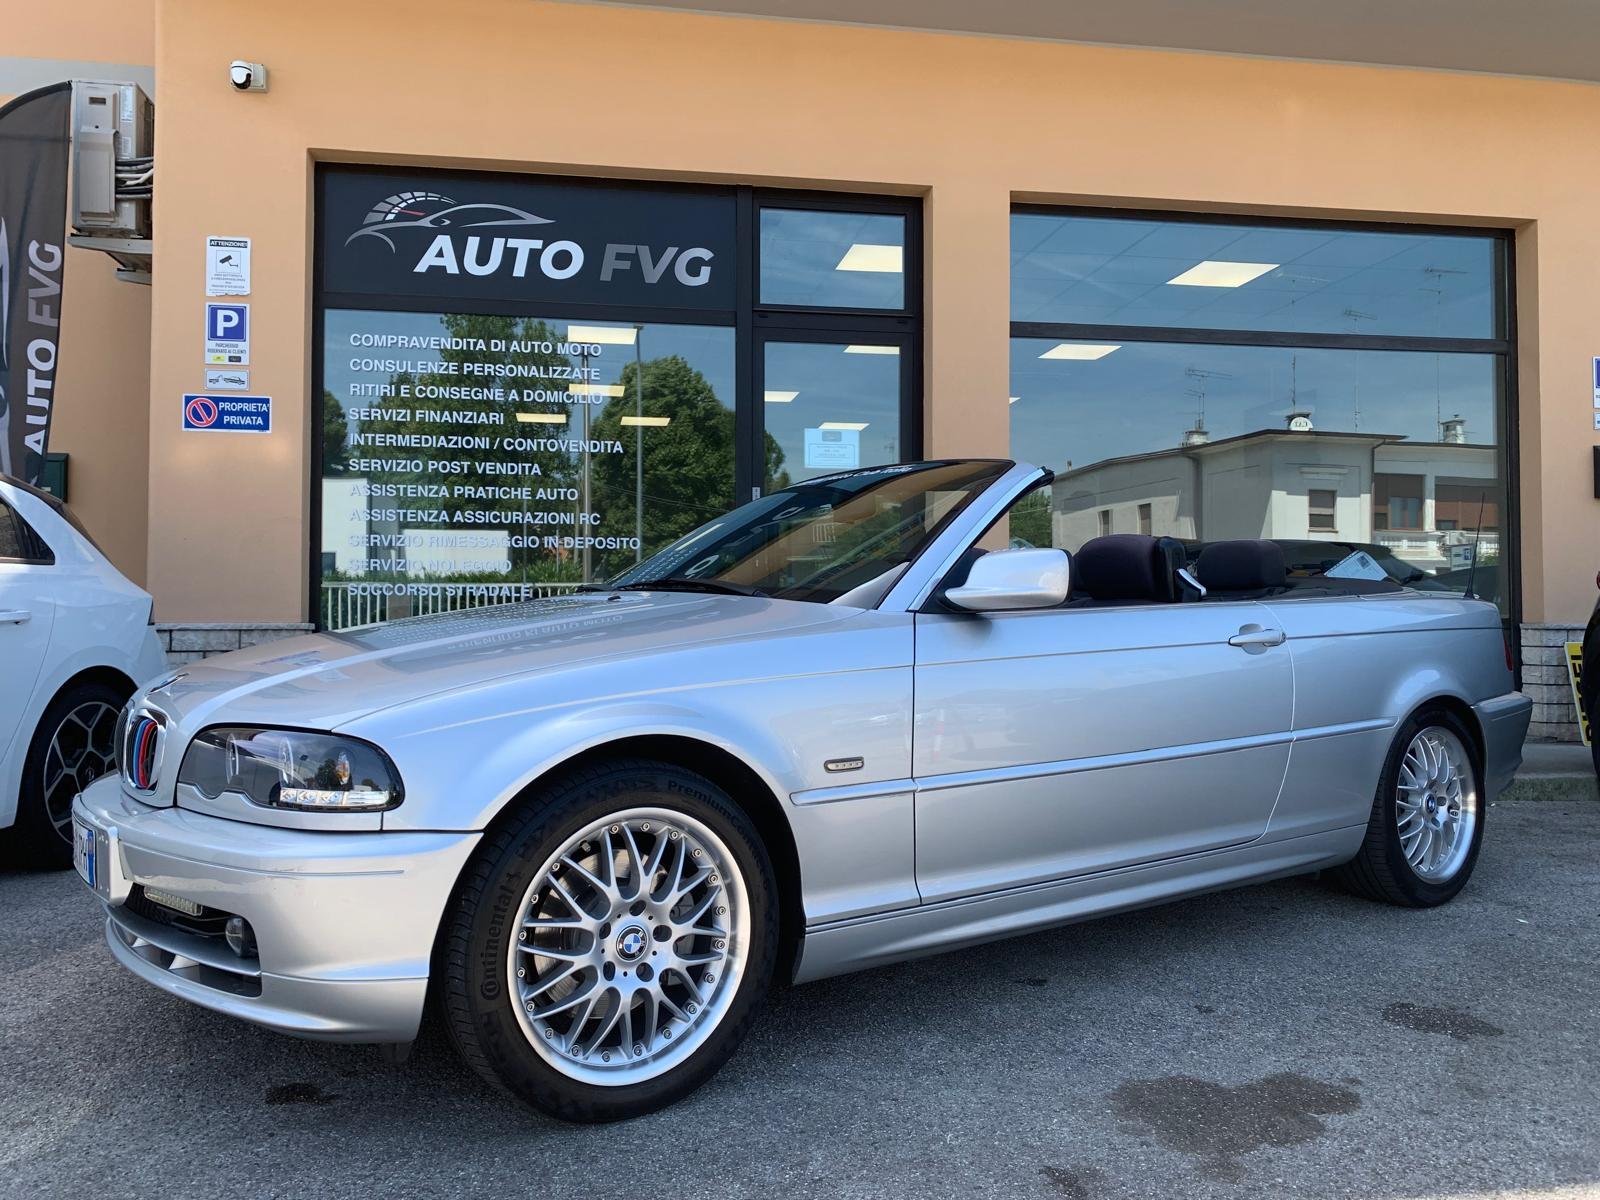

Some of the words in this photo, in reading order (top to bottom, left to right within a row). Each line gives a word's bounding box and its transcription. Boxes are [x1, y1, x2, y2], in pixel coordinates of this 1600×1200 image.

[413, 234, 584, 280] AUTO
[600, 243, 714, 287] FVG
[28, 240, 62, 328] FVG
[217, 310, 239, 337] P
[350, 333, 486, 351] COMPRAVENDITA
[490, 339, 506, 352] DI
[510, 340, 553, 354] AUTO
[557, 342, 602, 357] MOTO
[349, 358, 459, 375] CONSULENZE
[463, 362, 601, 380] PERSONALIZZATE
[24, 338, 57, 456] AUTO
[350, 383, 395, 397] RITIRI
[400, 385, 410, 398] E
[415, 386, 505, 401] CONSEGNE
[508, 389, 519, 402] A
[523, 389, 603, 405] DOMICILIO
[223, 415, 263, 425] PRIVATA
[348, 408, 411, 421] SERVIZI
[415, 410, 504, 424] FINANZIARI
[349, 432, 490, 449] INTERMEDIAZIONI
[503, 438, 624, 453] CONTOVENDITA
[348, 459, 423, 472] SERVIZIO
[428, 460, 471, 474] POST
[475, 462, 542, 476] VENDITA
[350, 484, 449, 498] ASSISTENZA
[454, 486, 532, 499] PRATICHE
[535, 488, 579, 500] AUTO
[350, 508, 449, 522] ASSISTENZA
[453, 510, 575, 525] ASSICURAZIONI
[579, 513, 601, 525] RC
[349, 534, 423, 548] SERVIZIO
[430, 535, 540, 549] RIMESSAGGIO
[544, 536, 559, 548] IN
[563, 537, 641, 549] DEPOSITO
[349, 558, 424, 572] SERVIZIO
[428, 559, 512, 573] NOLEGGIO
[347, 583, 441, 597] SOCCORSO
[445, 583, 531, 597] STRADALE
[480, 883, 516, 1001] Continental
